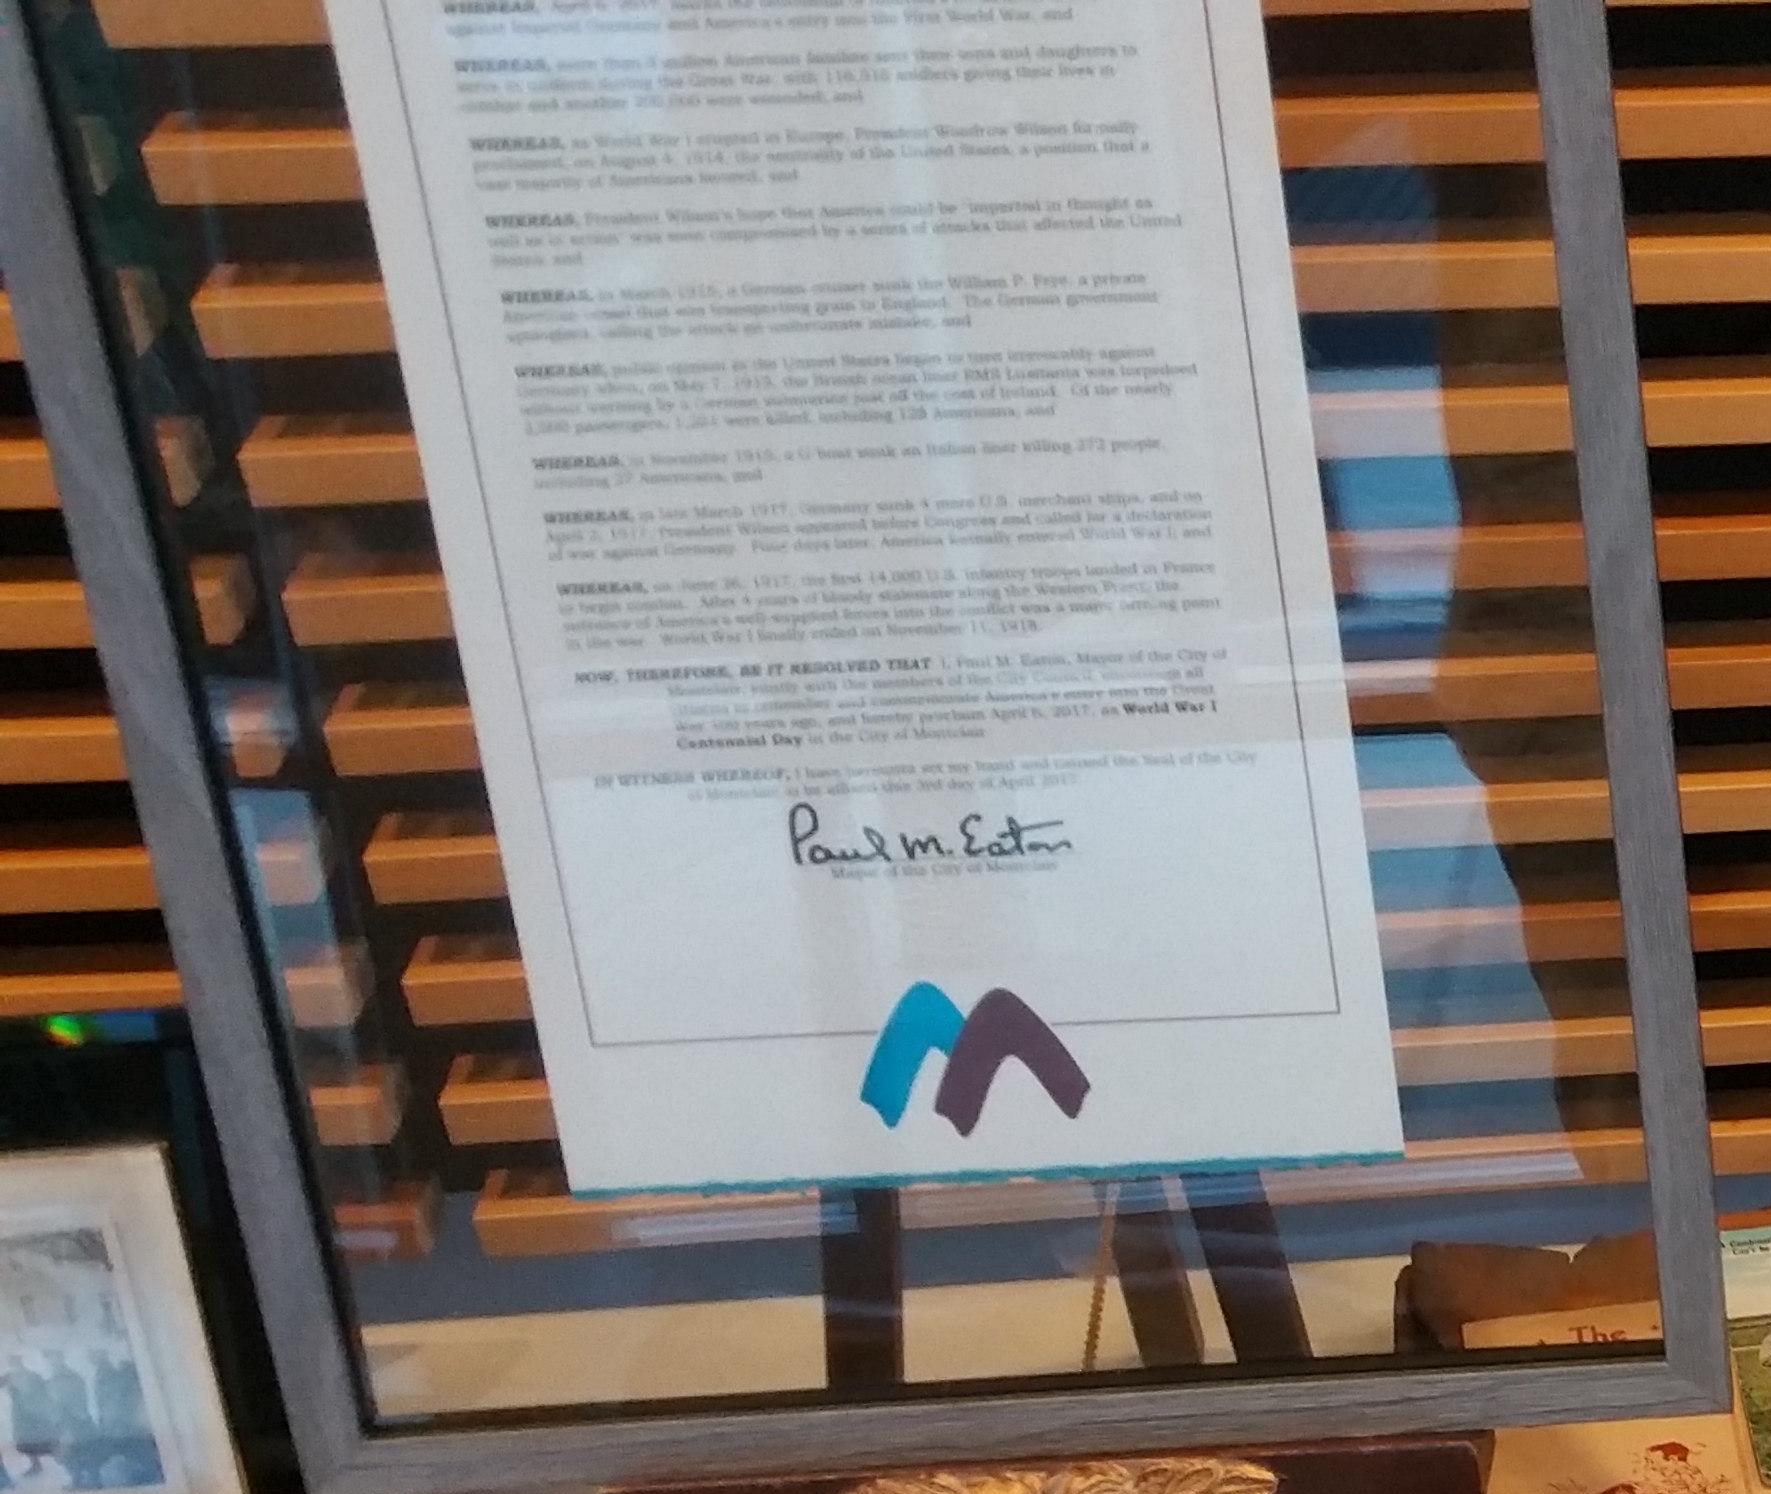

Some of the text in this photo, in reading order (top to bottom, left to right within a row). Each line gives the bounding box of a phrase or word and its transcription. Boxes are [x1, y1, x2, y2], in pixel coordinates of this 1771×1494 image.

[1123, 703, 1168, 714] World
[1175, 701, 1204, 713] War
[676, 732, 802, 749] Centennial Day
[789, 803, 891, 865] Paul
[960, 813, 1072, 858] Eaton
[1568, 1324, 1629, 1343] The
